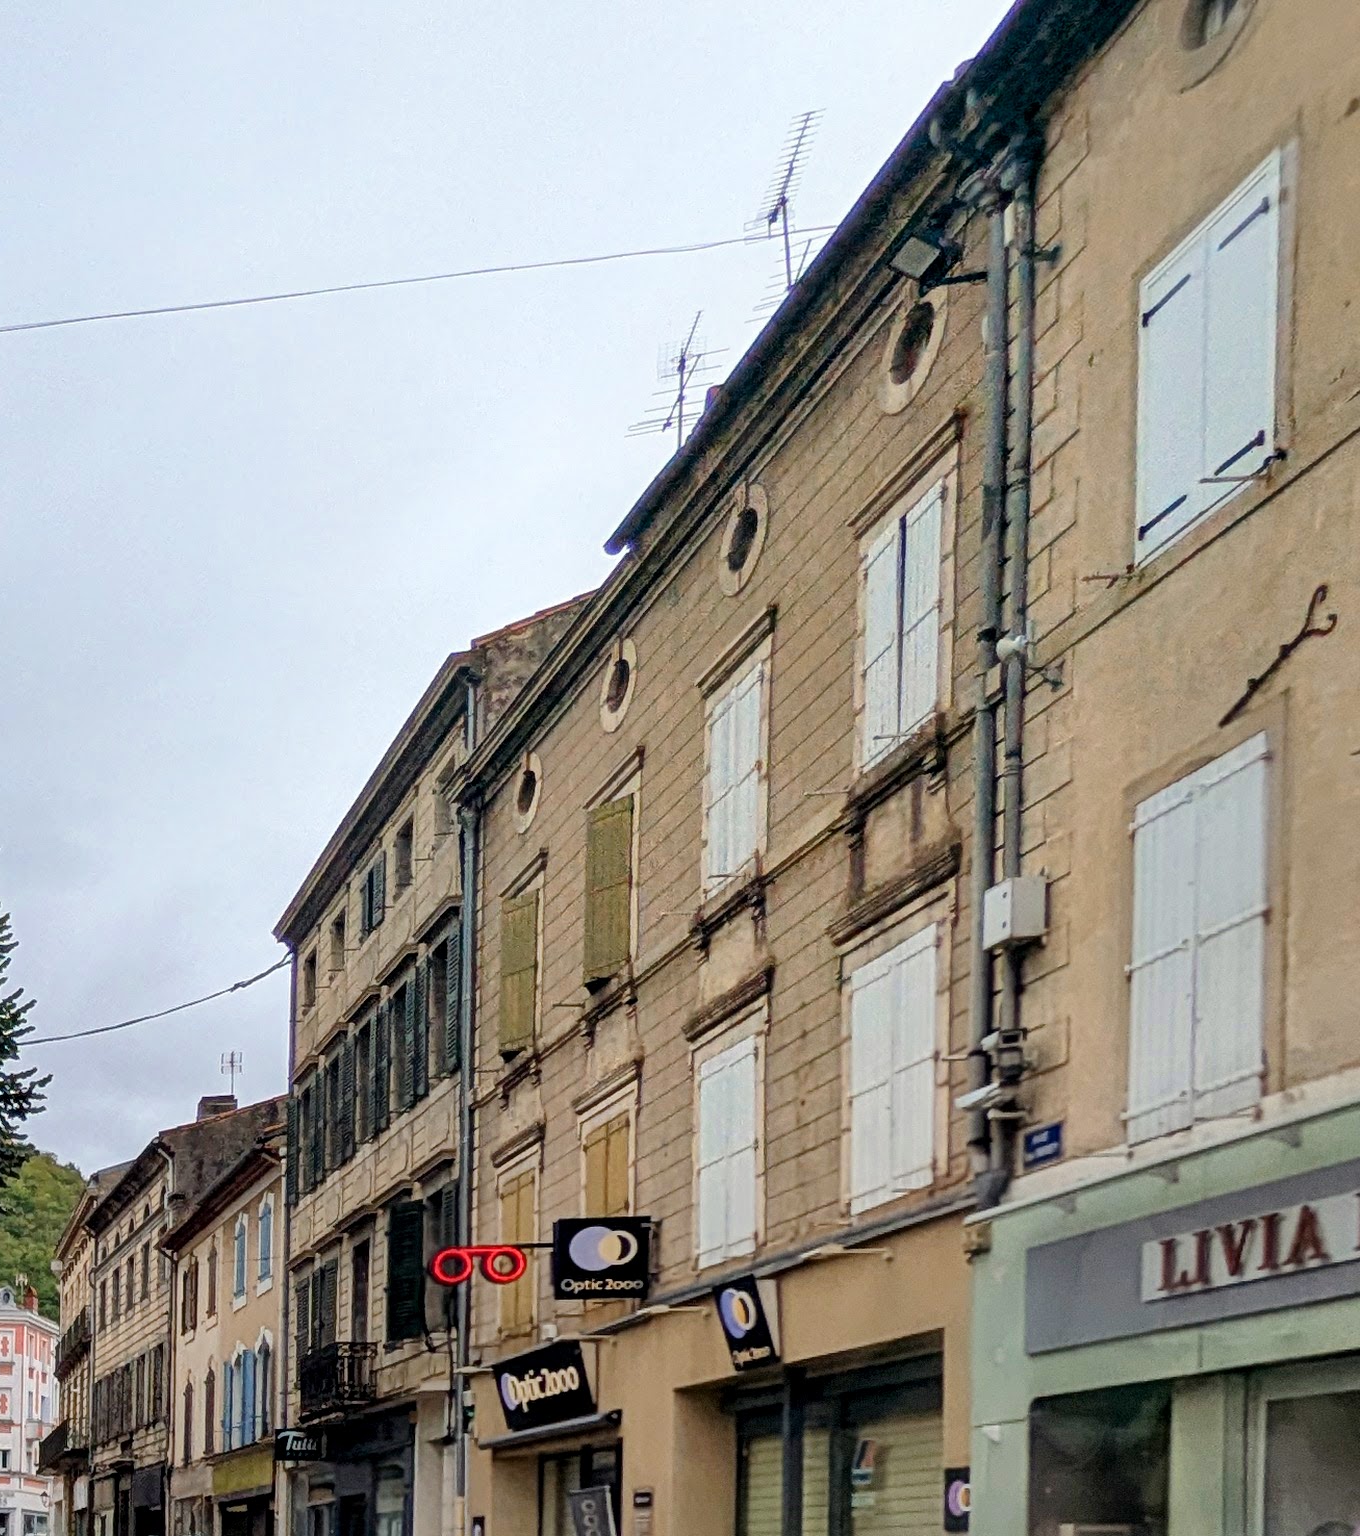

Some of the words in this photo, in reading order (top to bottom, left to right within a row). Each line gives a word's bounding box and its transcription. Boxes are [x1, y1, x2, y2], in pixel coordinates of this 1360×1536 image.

[1157, 1205, 1332, 1292] LIVIA
[561, 1278, 603, 1294] Optic
[605, 1278, 643, 1290] 2000
[509, 1369, 542, 1412] Optic
[541, 1366, 579, 1396] 2000
